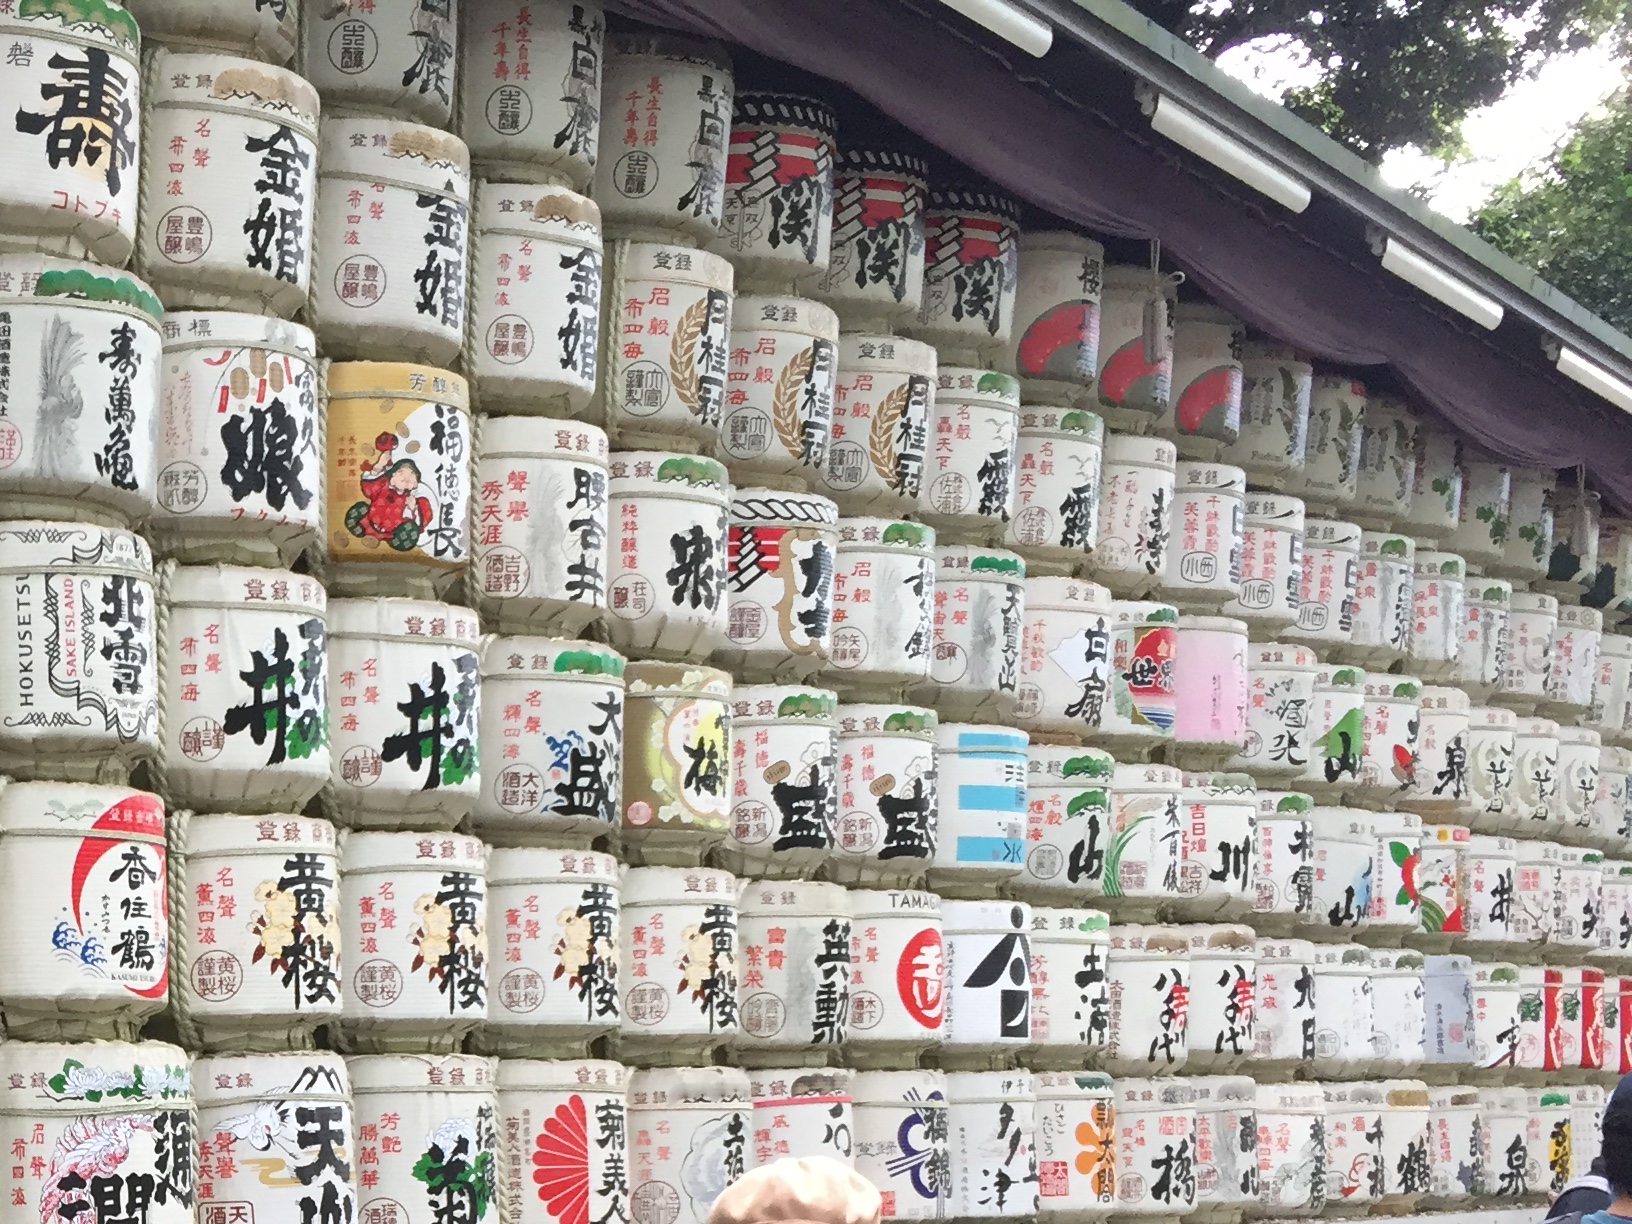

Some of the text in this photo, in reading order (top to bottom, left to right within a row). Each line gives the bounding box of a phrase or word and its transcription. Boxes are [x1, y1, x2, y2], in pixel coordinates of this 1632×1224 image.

[171, 73, 214, 90] 登録
[653, 251, 693, 273] 登録
[63, 578, 78, 677] SAKE ISLAND
[520, 771, 540, 807] 大洋
[256, 820, 302, 843] 登録
[109, 845, 157, 972] 香住鶴
